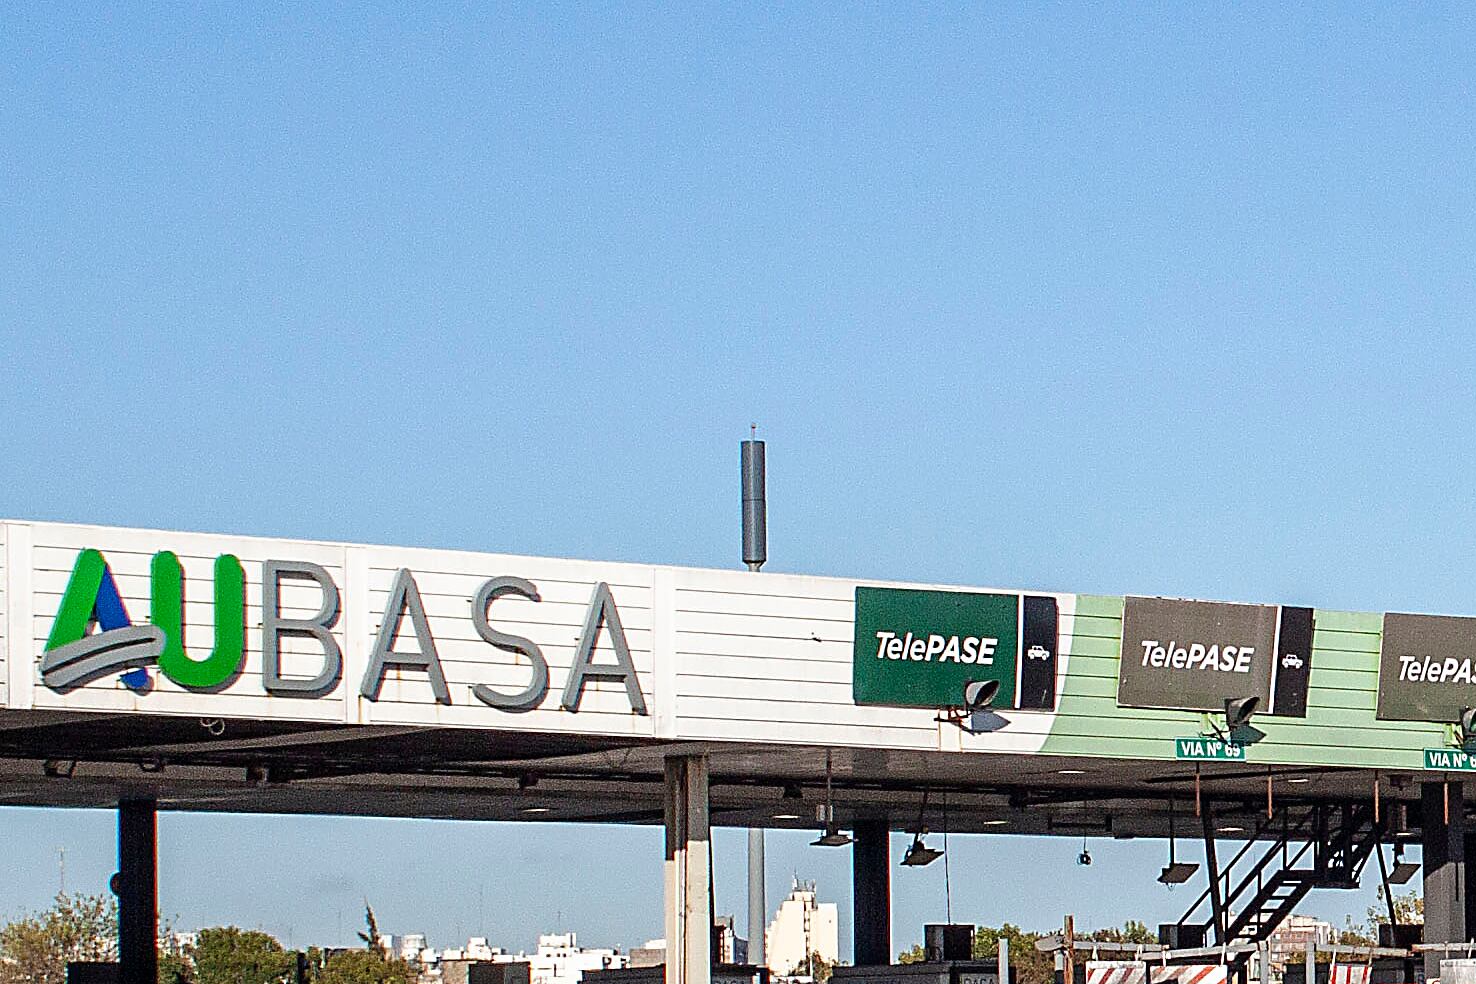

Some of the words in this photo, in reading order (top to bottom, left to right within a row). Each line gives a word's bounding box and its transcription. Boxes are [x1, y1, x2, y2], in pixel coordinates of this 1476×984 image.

[39, 548, 649, 717] AUBASA
[875, 631, 998, 666] TelePASE
[1140, 639, 1255, 673] TelePASE
[1181, 741, 1204, 756] VIA
[1225, 743, 1240, 757] 69
[1429, 752, 1450, 767] VIA
